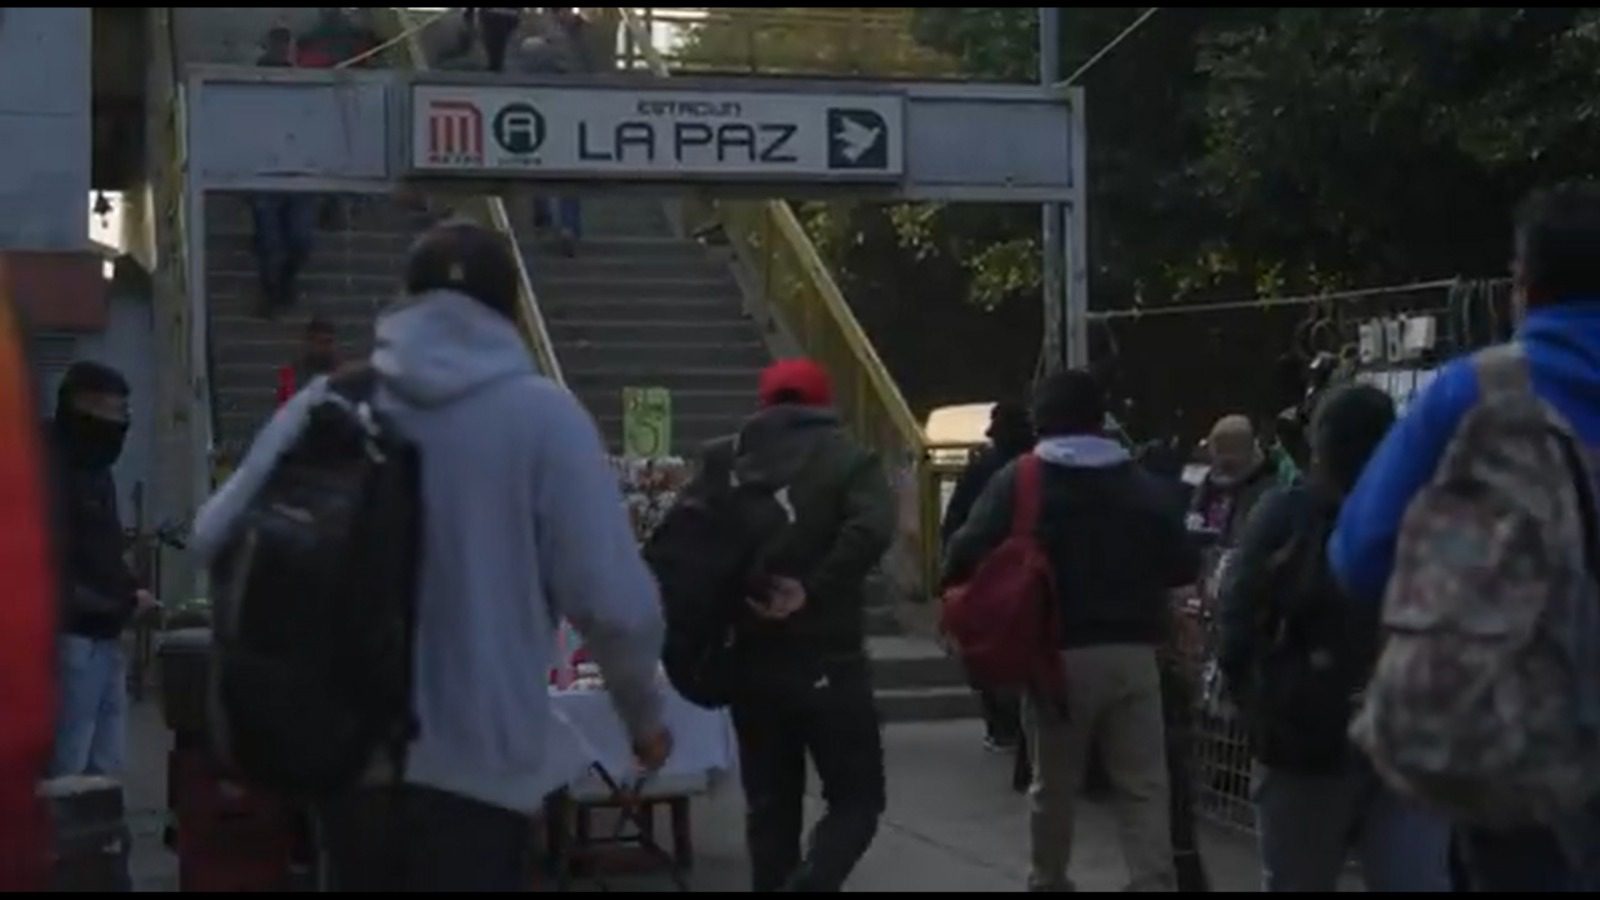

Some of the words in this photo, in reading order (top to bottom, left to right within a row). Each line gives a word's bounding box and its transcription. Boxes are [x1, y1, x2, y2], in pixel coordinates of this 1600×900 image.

[502, 110, 537, 149] A
[578, 121, 655, 162] LA
[674, 121, 798, 163] PAZ
